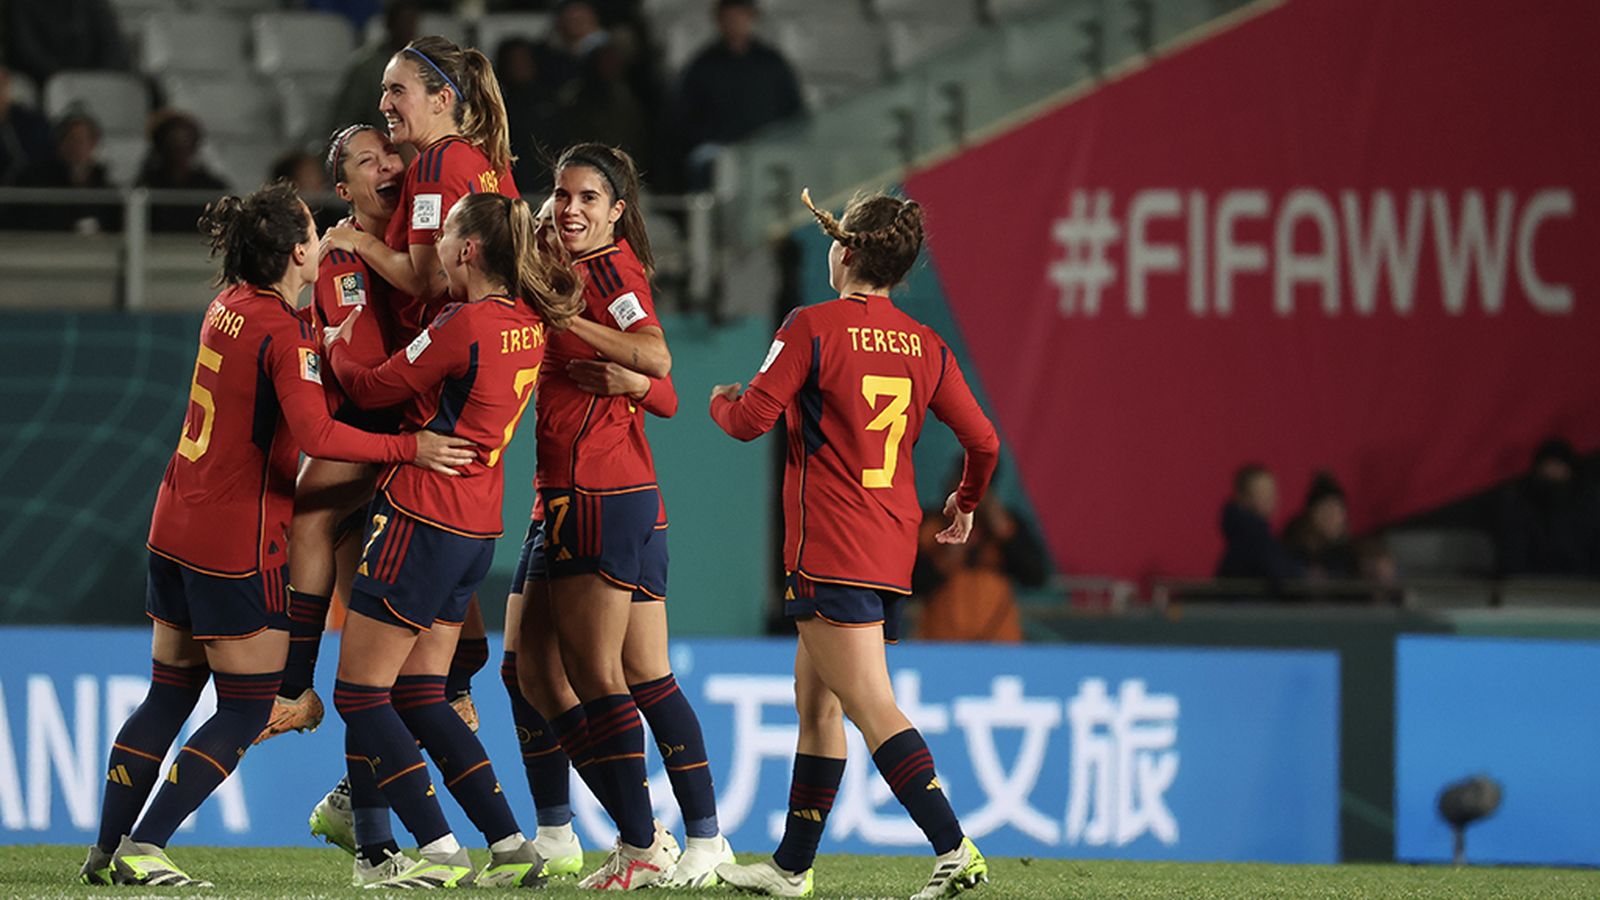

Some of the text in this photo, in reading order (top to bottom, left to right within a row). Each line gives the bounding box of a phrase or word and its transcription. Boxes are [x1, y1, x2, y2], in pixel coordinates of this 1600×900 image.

[1049, 188, 1574, 316] #FIFAWWC
[847, 327, 922, 357] TERESA
[177, 344, 223, 462] 5
[487, 362, 542, 467] 7
[861, 374, 912, 488] 3
